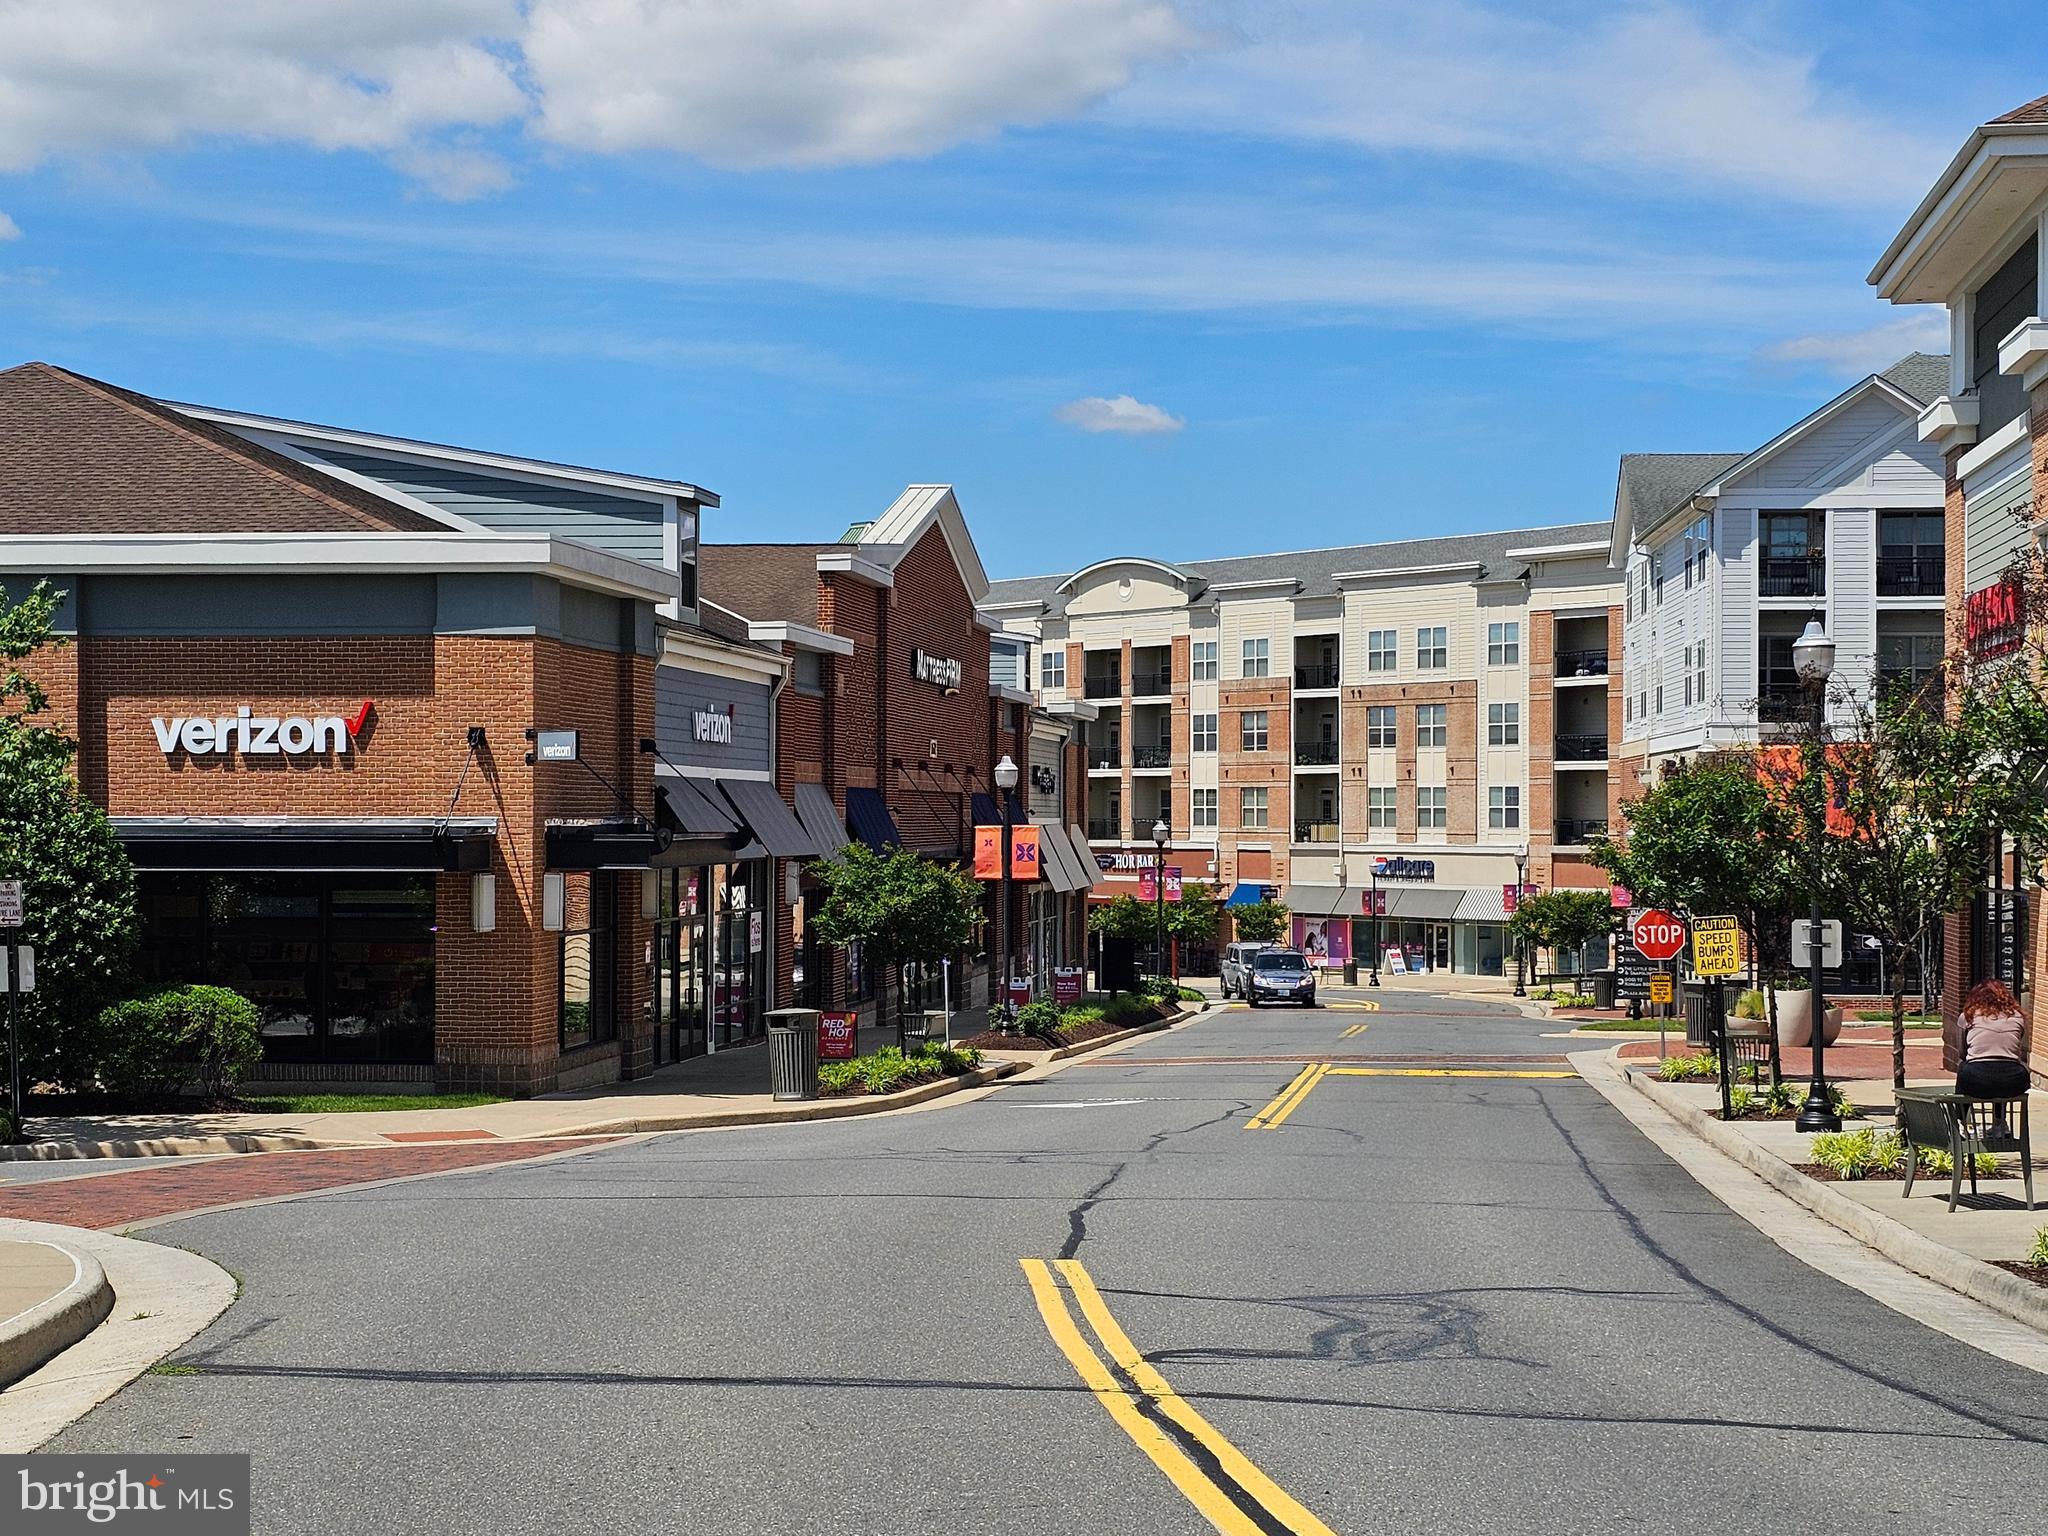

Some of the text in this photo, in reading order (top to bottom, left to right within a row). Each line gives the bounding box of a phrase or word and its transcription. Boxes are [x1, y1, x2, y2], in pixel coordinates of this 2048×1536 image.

[151, 705, 347, 754] verizon
[692, 703, 732, 744] verizon
[542, 741, 571, 758] verizon
[1137, 853, 1154, 869] BAR
[1694, 919, 1735, 931] CAUTION
[1637, 925, 1682, 944] STOP
[1699, 933, 1732, 945] SPEED
[1698, 945, 1734, 958] BUMPS
[1700, 957, 1734, 971] AHEAD
[822, 1020, 845, 1028] RED
[828, 1028, 852, 1037] HOT
